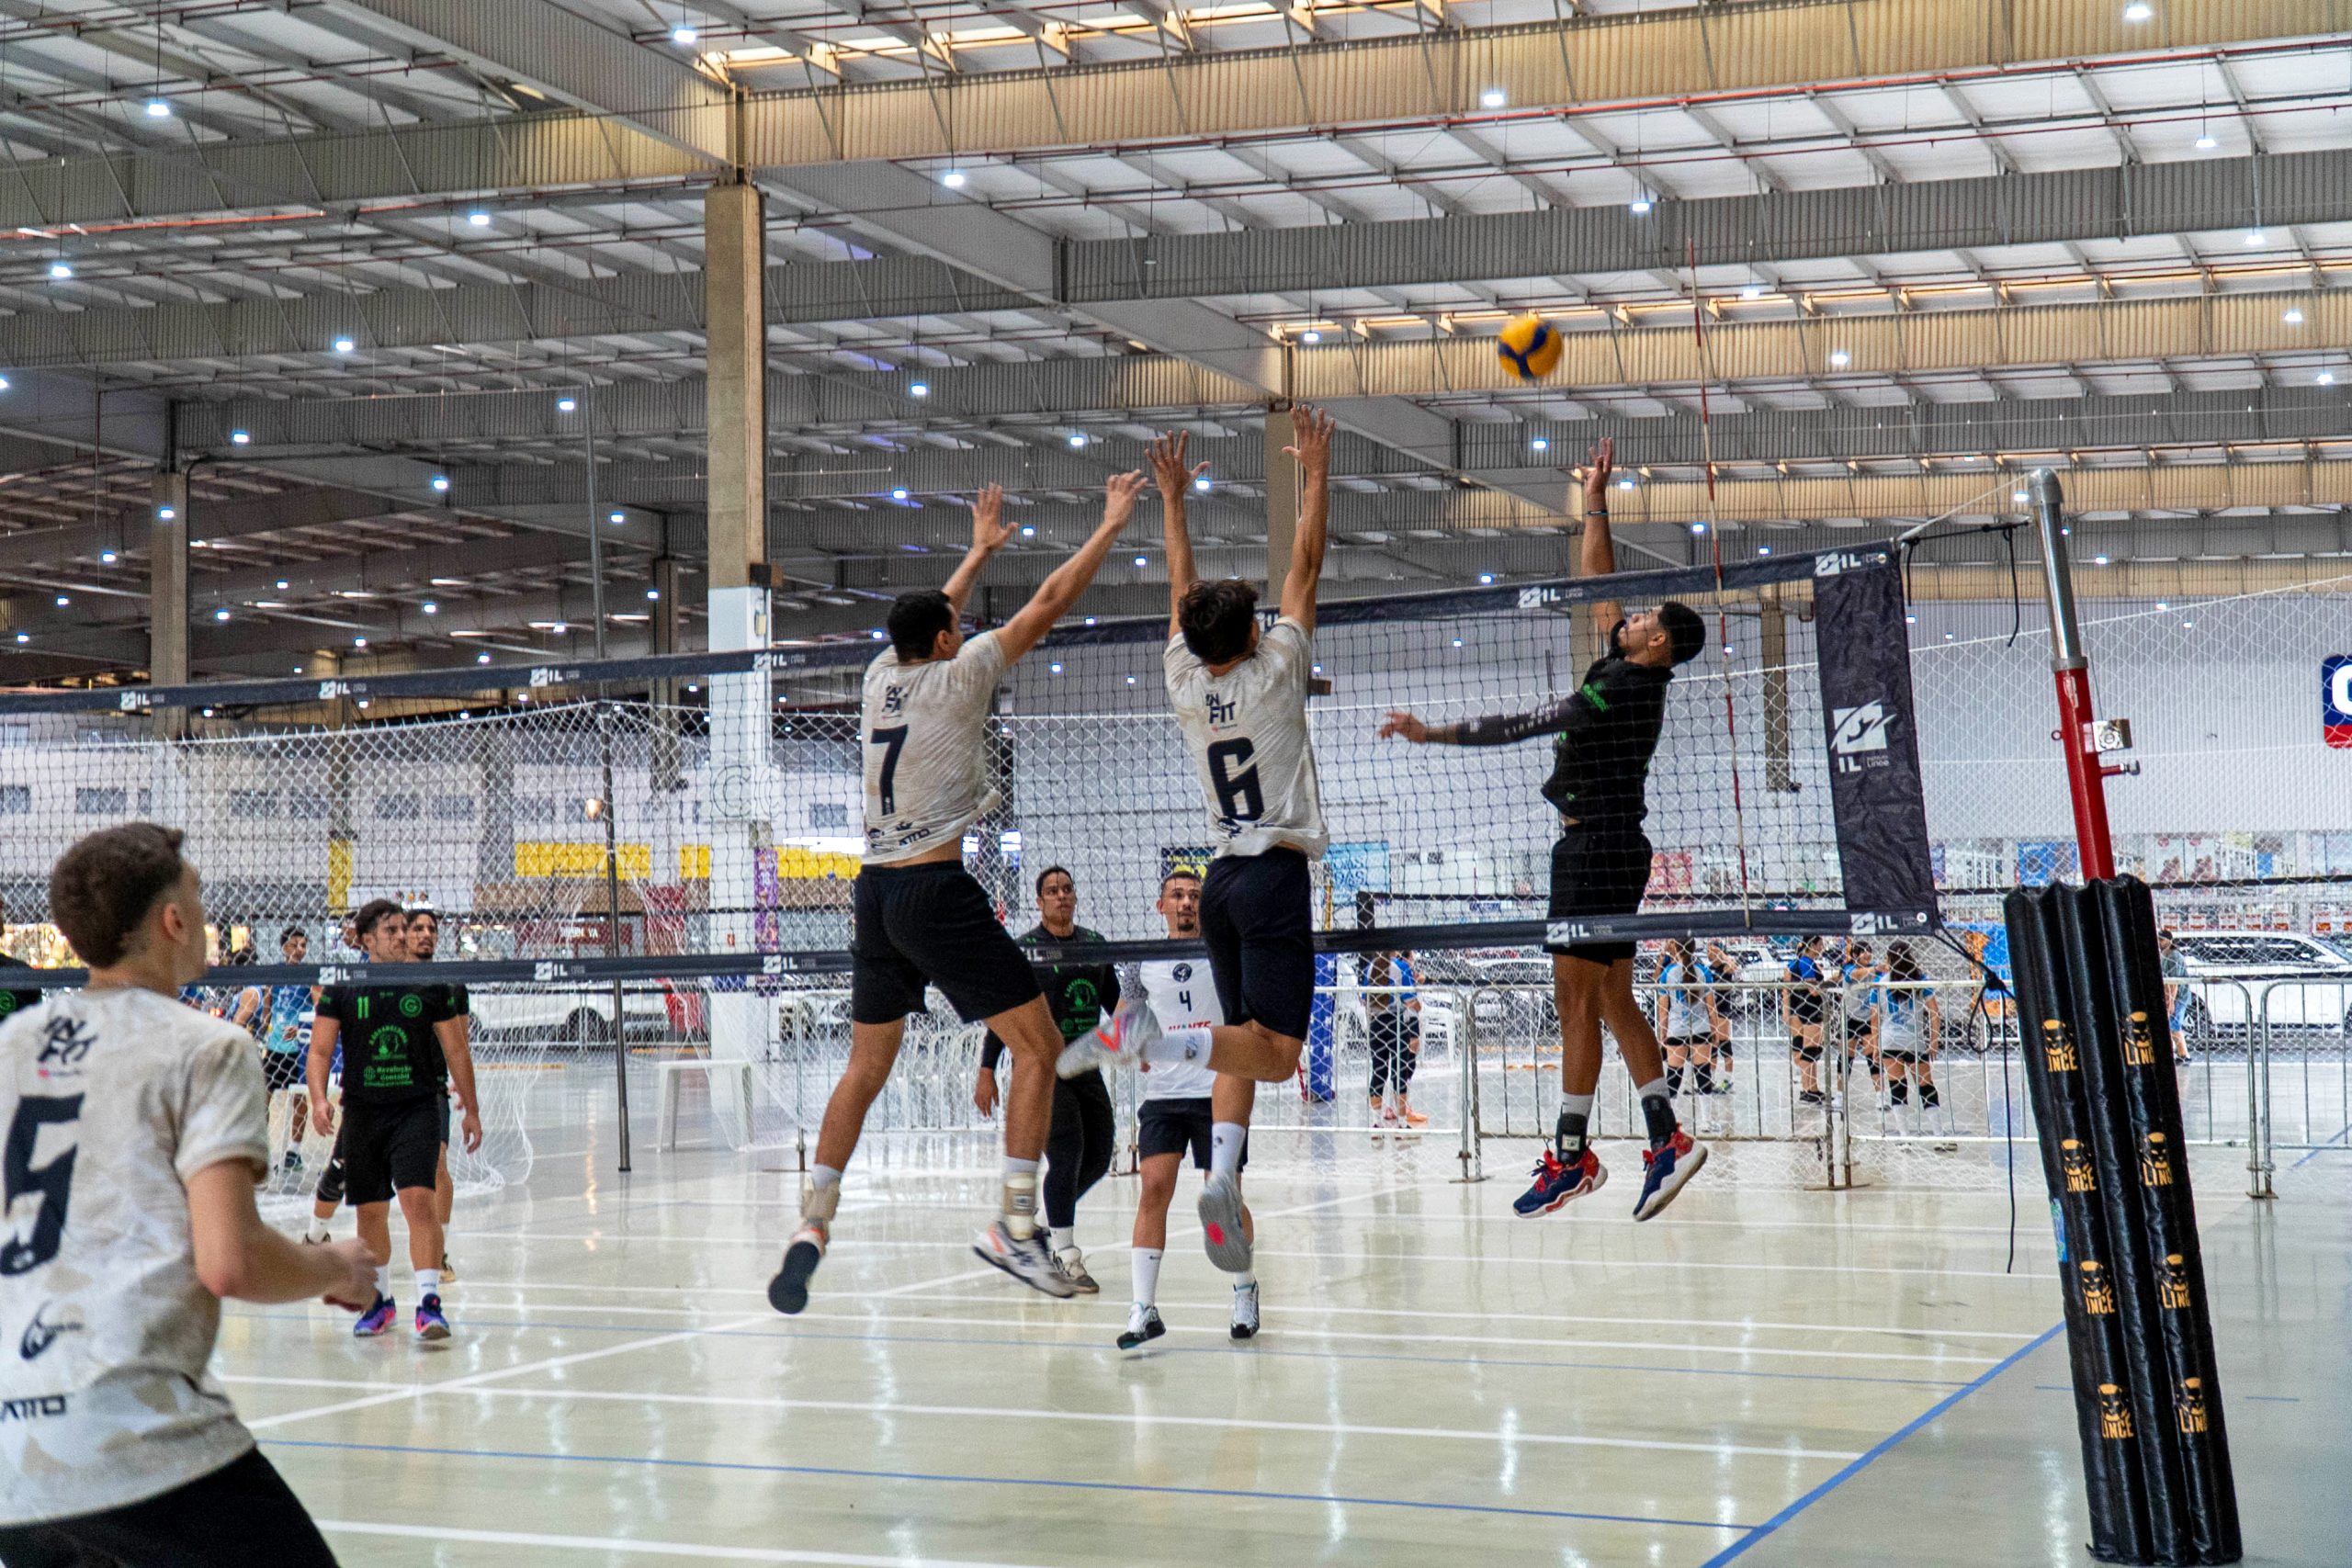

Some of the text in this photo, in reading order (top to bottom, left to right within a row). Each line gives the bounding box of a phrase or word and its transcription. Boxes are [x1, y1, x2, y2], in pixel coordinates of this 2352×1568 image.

[1841, 553, 1861, 569] IL
[1544, 588, 1561, 602] IL
[1209, 701, 1236, 724] FIT
[870, 724, 908, 816] 7
[1838, 756, 1861, 773] IL
[1207, 737, 1264, 821] 6
[1571, 923, 1589, 938] IL
[1877, 915, 1898, 930] IL
[336, 967, 350, 981] IL
[553, 964, 568, 976] IL
[357, 996, 369, 1020] 11
[1179, 990, 1192, 1012] 4
[0, 1091, 85, 1276] 5
